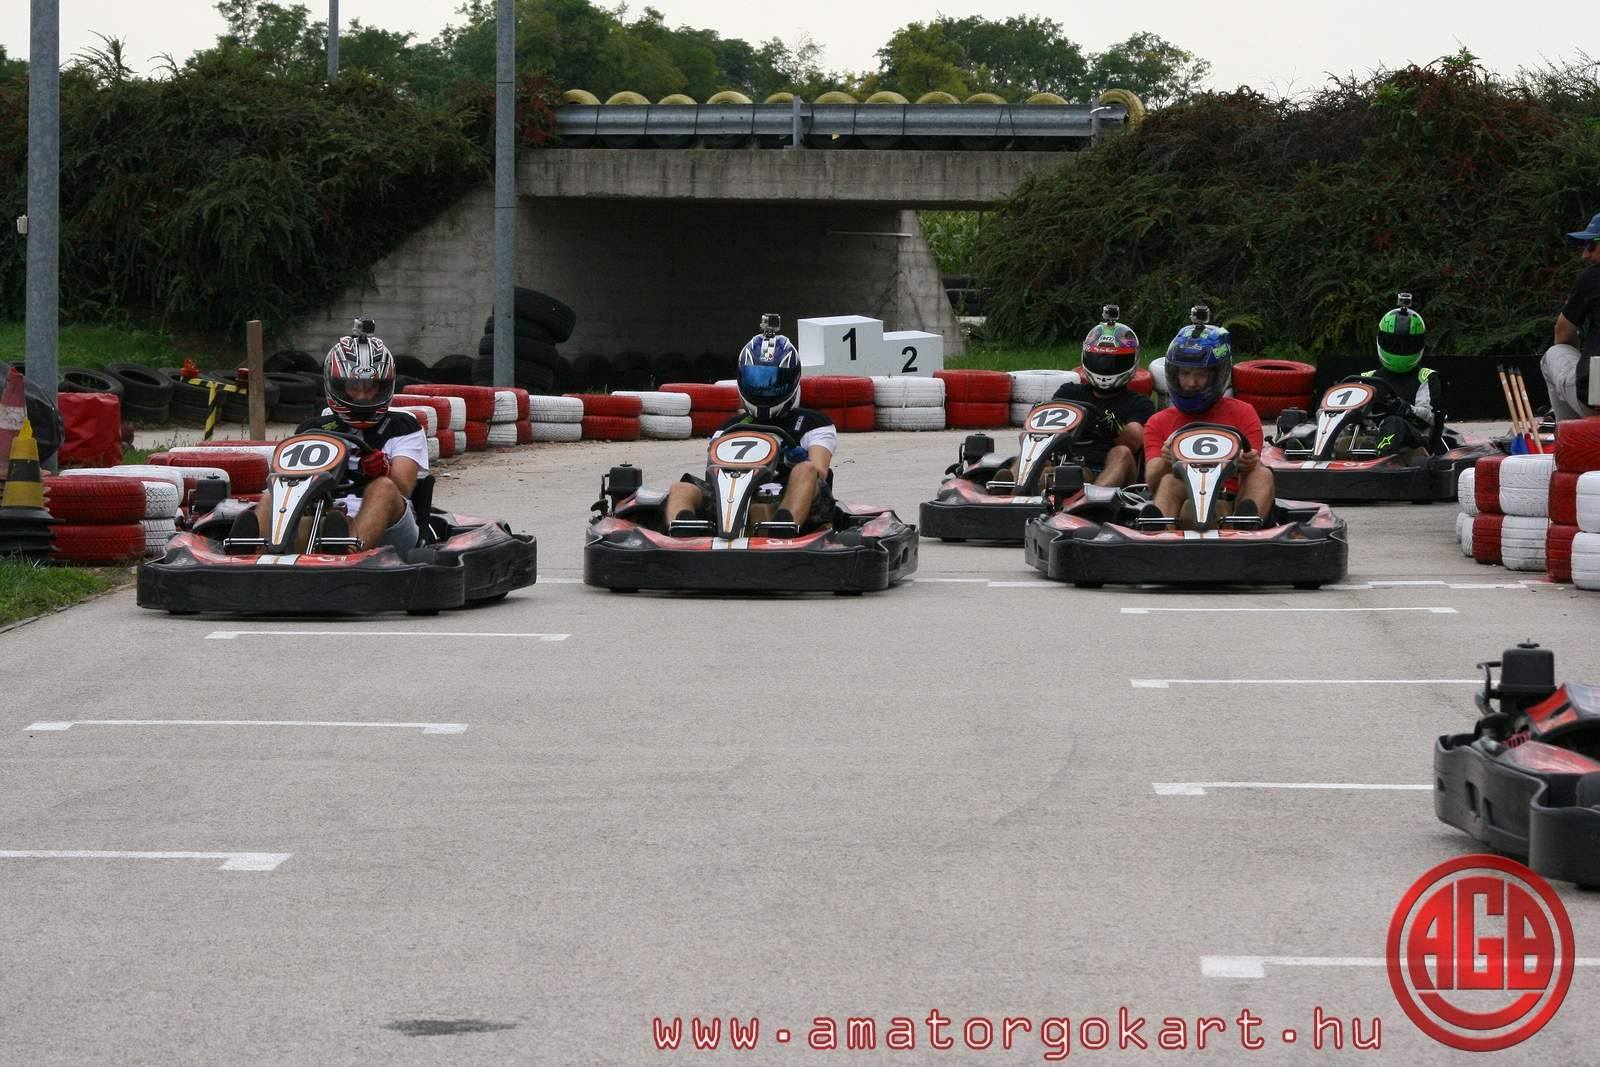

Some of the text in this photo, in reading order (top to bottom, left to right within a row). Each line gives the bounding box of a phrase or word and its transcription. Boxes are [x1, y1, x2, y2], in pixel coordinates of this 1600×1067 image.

[842, 327, 857, 361] 1
[901, 346, 918, 373] 2
[1336, 390, 1353, 405] 1
[1032, 409, 1070, 428] 12
[282, 444, 331, 467] 10
[731, 440, 758, 460] 7
[1192, 436, 1219, 456] 6
